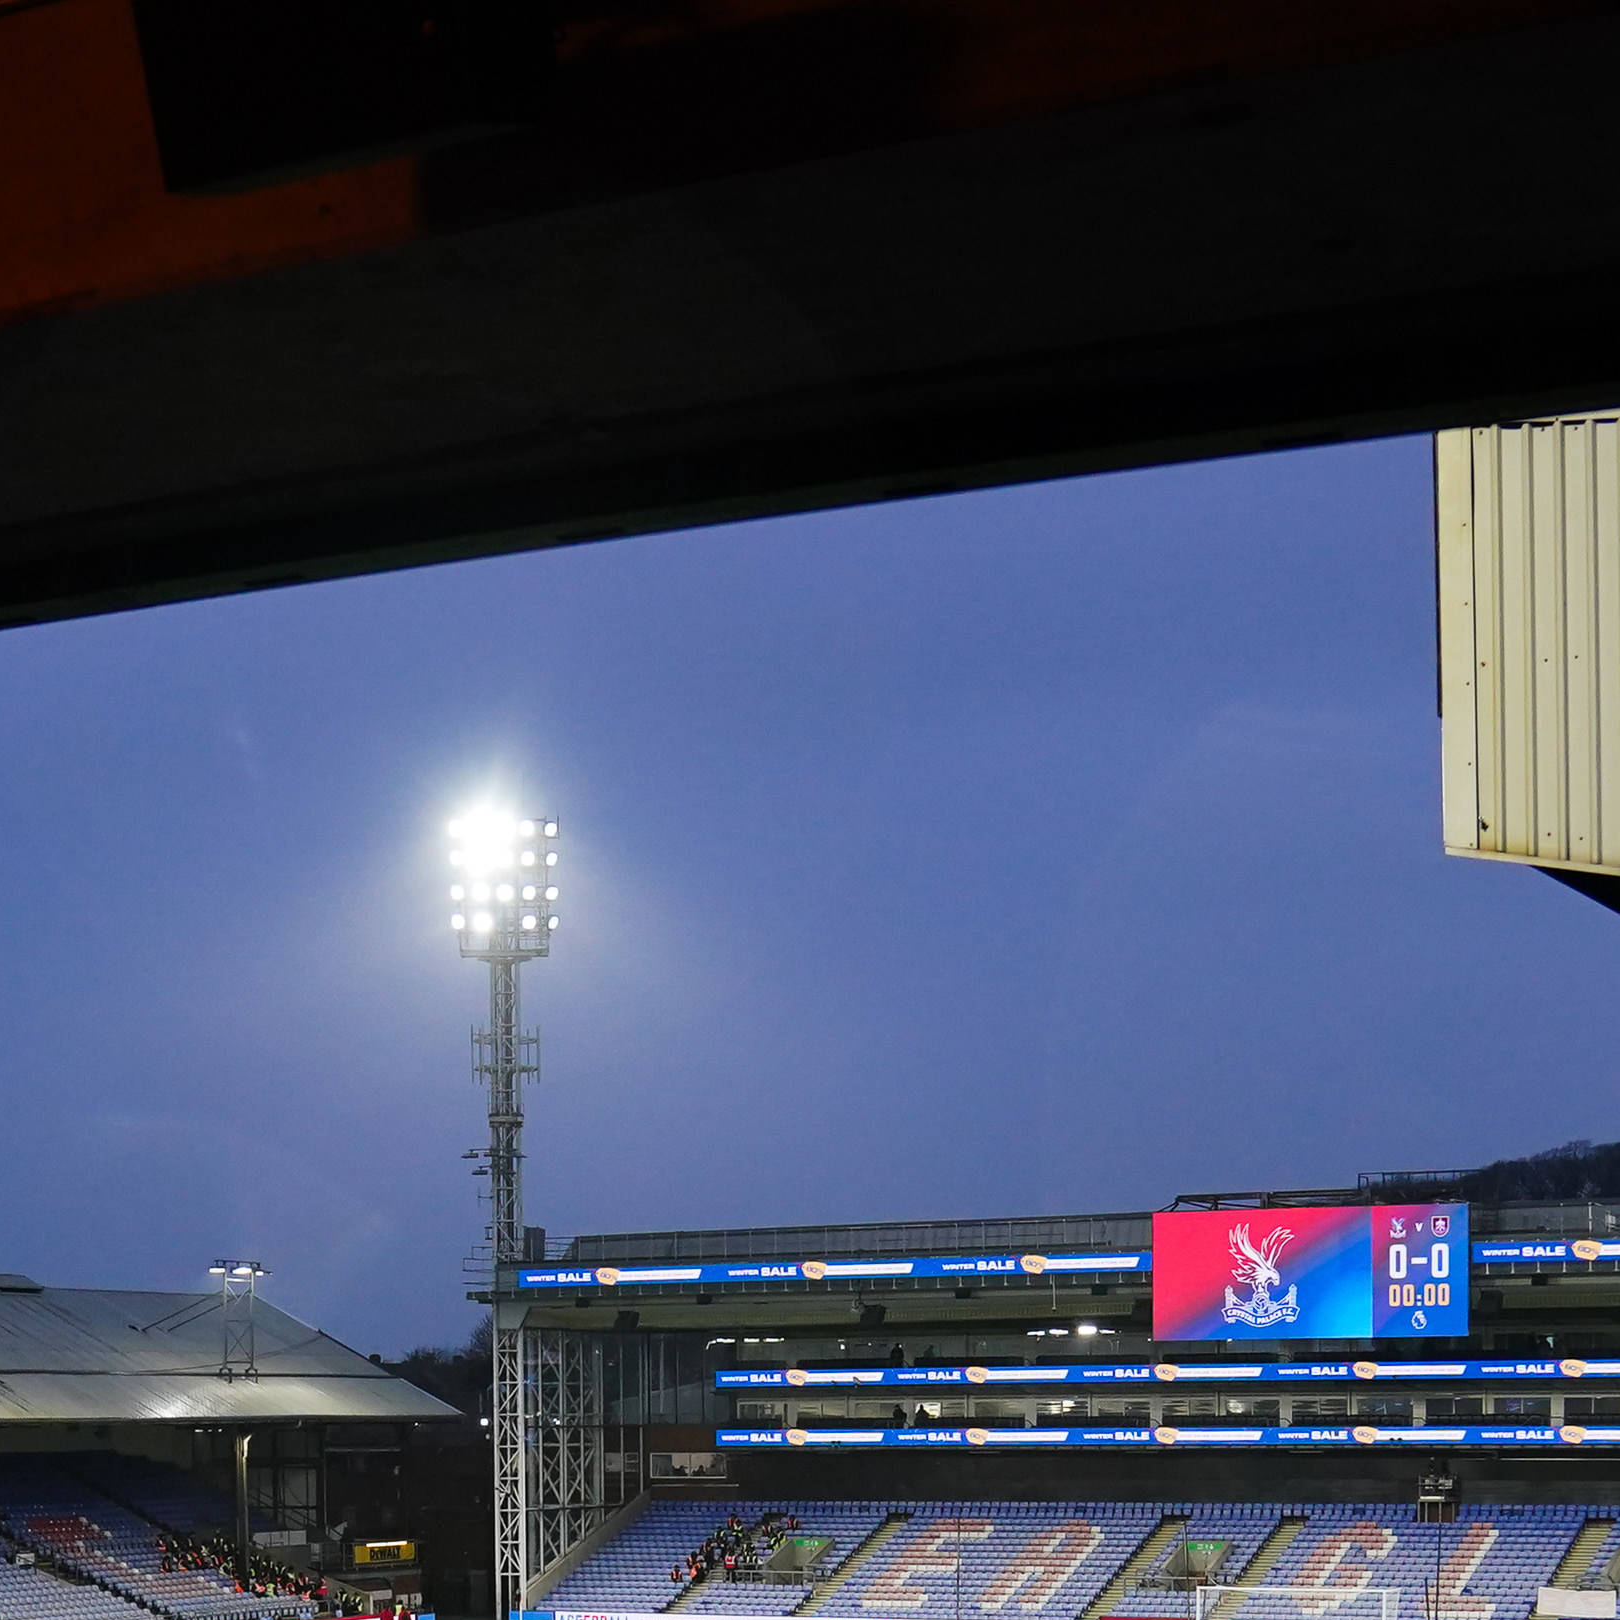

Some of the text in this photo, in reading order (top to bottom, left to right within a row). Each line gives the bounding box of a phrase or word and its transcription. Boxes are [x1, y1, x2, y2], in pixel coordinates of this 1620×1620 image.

[1522, 1246, 1565, 1257] SALE
[977, 1260, 1015, 1271] SALE
[761, 1267, 796, 1277] SALE
[558, 1273, 591, 1283] SALE
[1389, 1283, 1450, 1307] 00:00
[1227, 1309, 1256, 1323] CRYSTAL
[1257, 1310, 1282, 1324] PALACE
[1115, 1369, 1149, 1378] SALE
[1311, 1367, 1347, 1376] SALE
[1516, 1364, 1554, 1374] SALE
[750, 1374, 781, 1383] SALE
[928, 1371, 960, 1381] SALE
[750, 1434, 782, 1443] SALE
[928, 1432, 961, 1442] SALE
[1115, 1432, 1149, 1441] SALE
[1311, 1431, 1348, 1441] SALE
[1516, 1431, 1554, 1440] SALE
